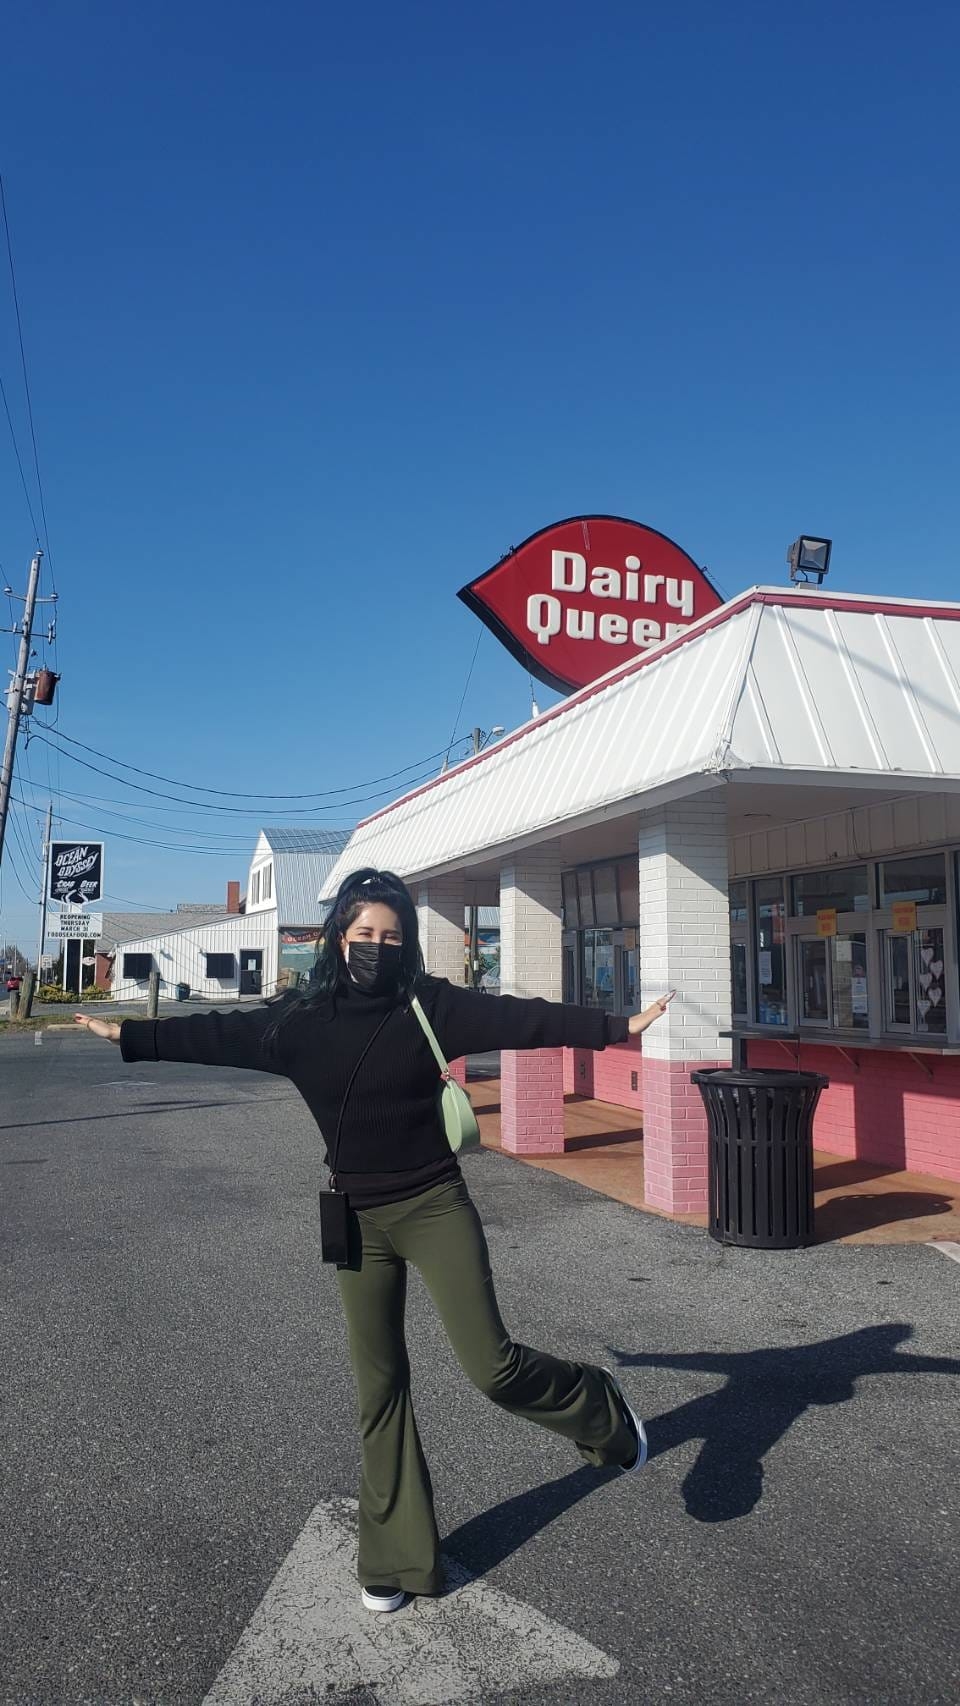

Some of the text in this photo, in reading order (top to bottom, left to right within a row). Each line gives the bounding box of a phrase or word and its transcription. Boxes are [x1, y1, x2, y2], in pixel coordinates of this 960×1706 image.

[552, 550, 694, 617] Dairy
[55, 846, 89, 867] OCEAN
[57, 852, 99, 877] ODYSSEY
